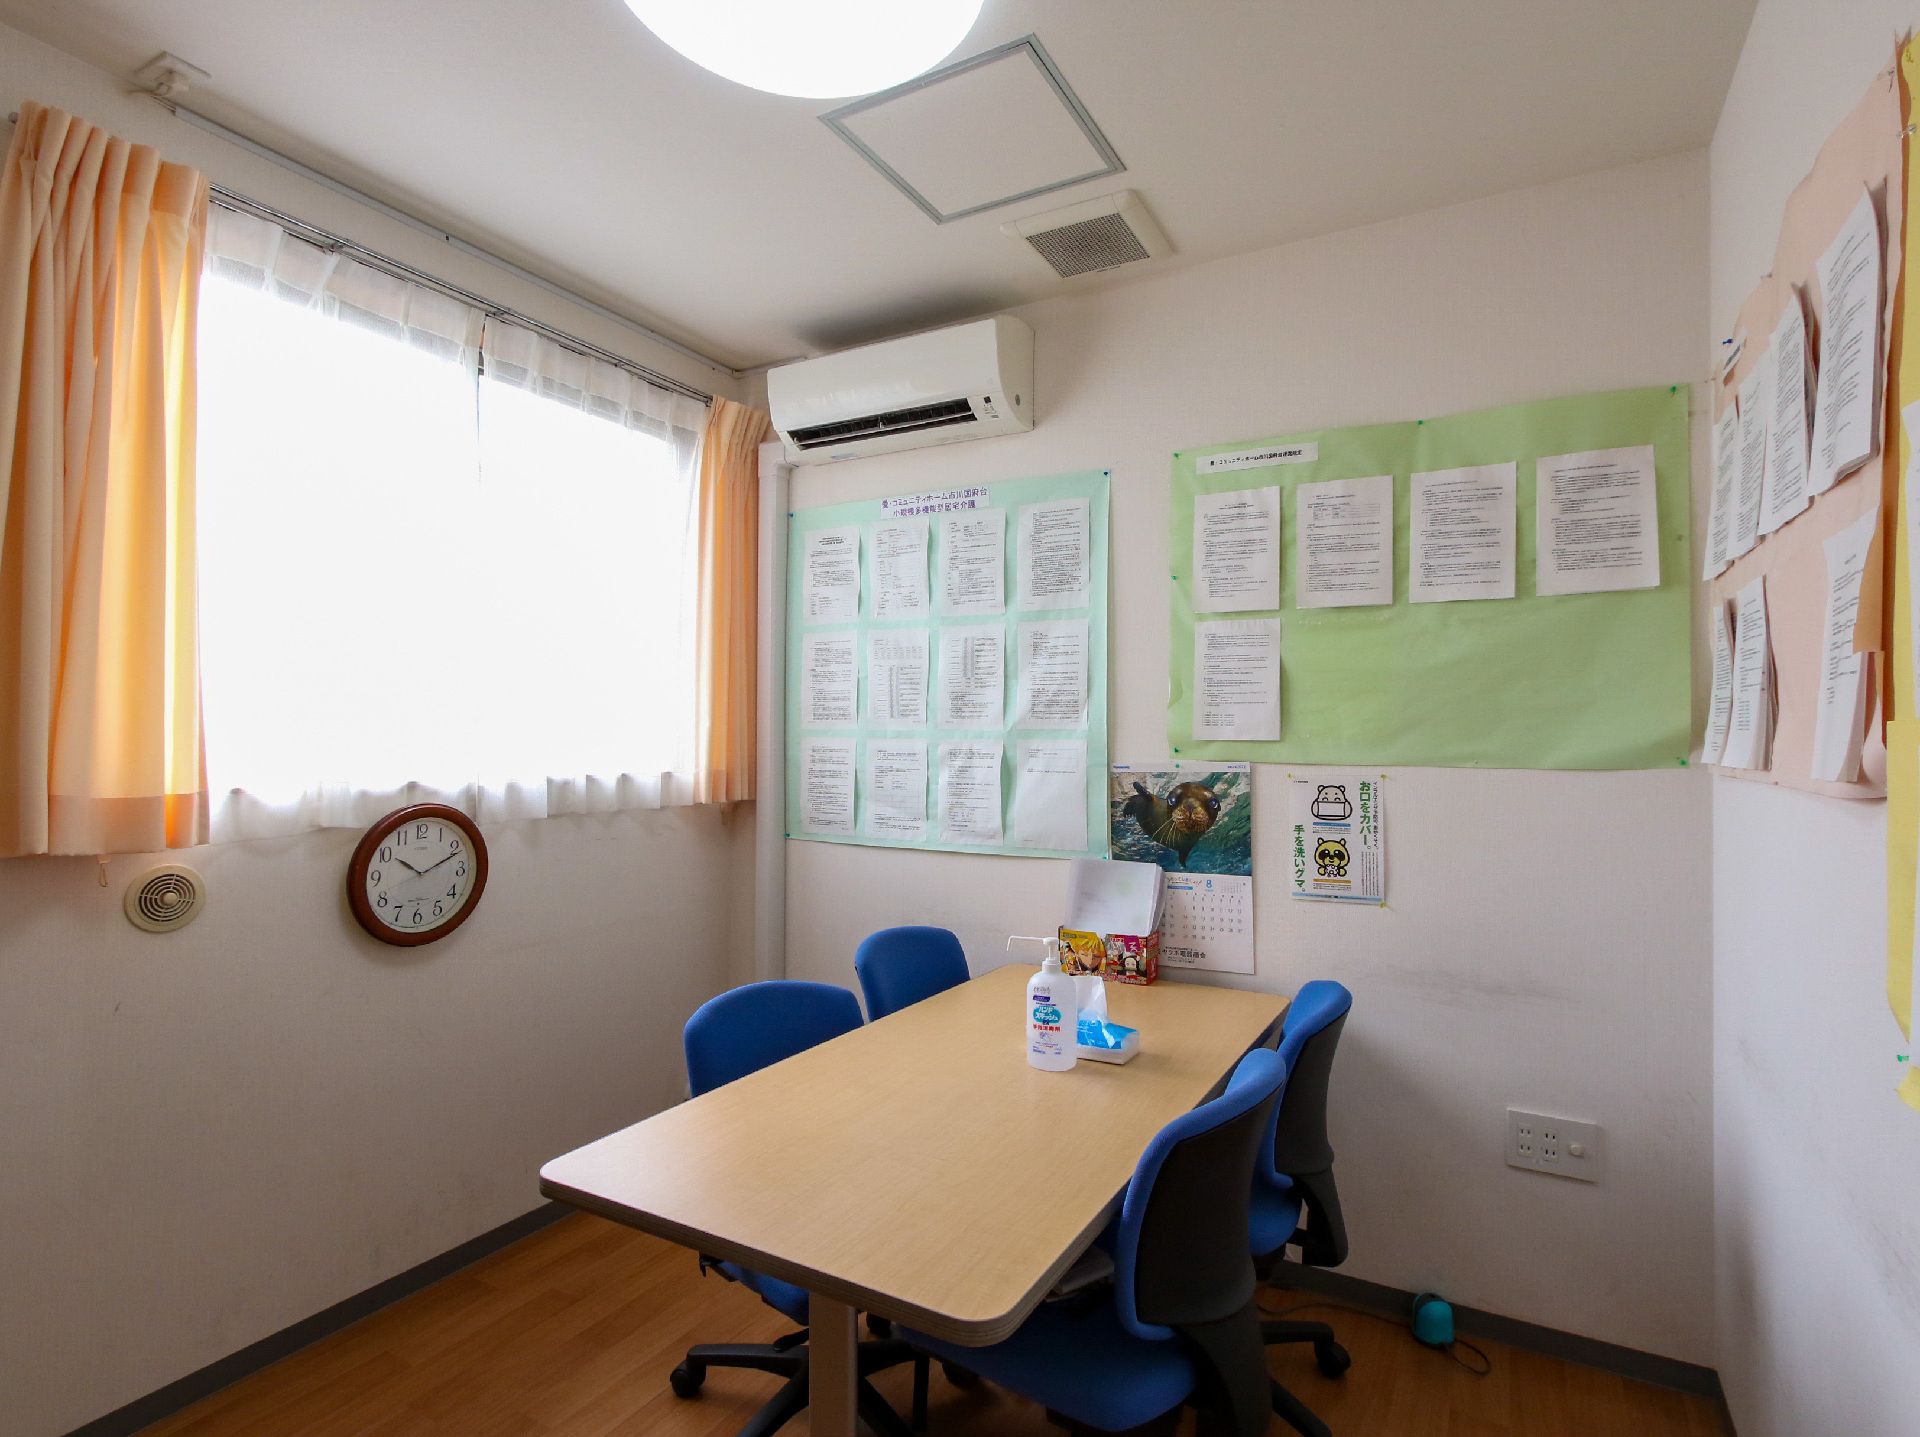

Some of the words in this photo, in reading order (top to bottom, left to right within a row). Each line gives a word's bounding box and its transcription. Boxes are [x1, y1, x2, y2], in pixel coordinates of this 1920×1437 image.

[397, 830, 408, 846] 11
[416, 823, 429, 840] 12
[439, 827, 443, 842] 1
[379, 846, 392, 863] 10
[449, 840, 460, 857] 2
[1293, 824, 1306, 893] 手を洗いグマ。
[455, 861, 466, 877] 3
[370, 869, 382, 887] 9
[1206, 879, 1213, 889] 8
[377, 891, 388, 908] 8
[446, 883, 457, 899] 4
[393, 905, 403, 922] 7
[412, 907, 423, 925] 6
[432, 900, 443, 917] 5
